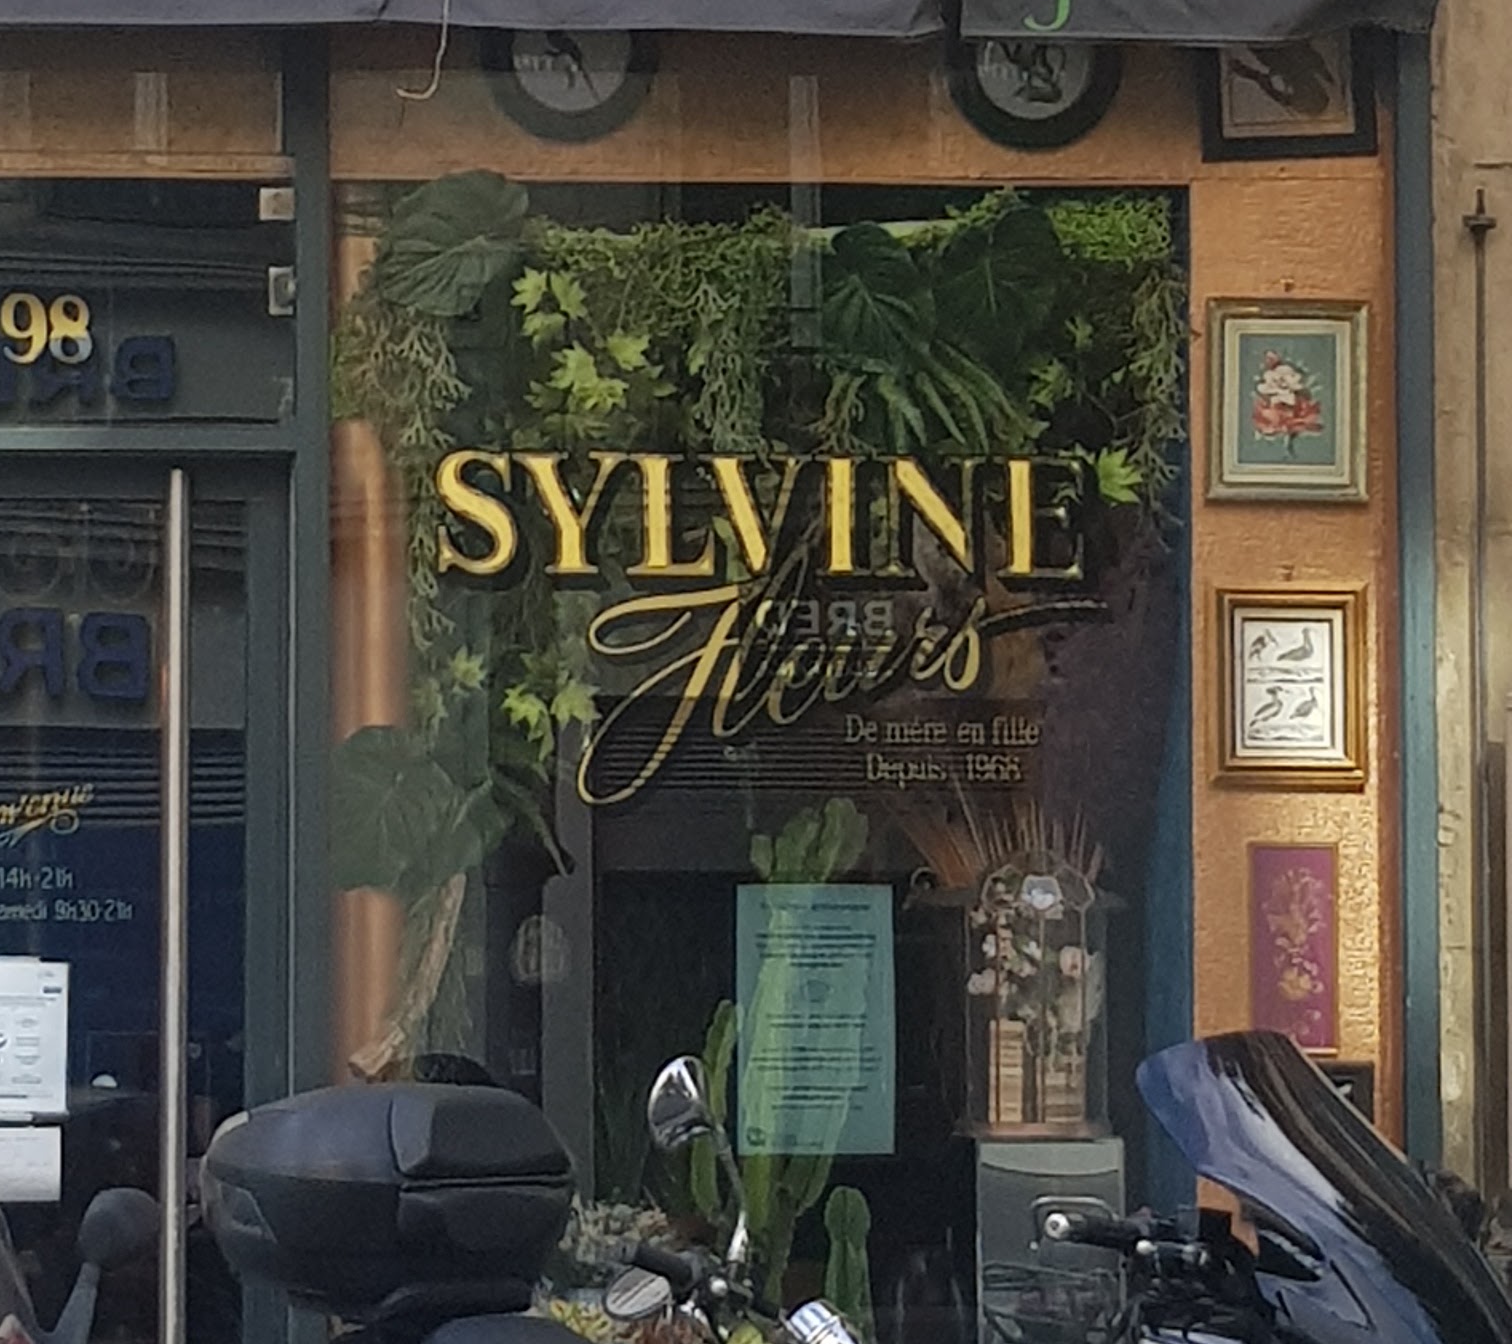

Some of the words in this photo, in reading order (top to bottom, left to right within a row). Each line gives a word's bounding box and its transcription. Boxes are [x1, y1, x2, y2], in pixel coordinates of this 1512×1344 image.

[0, 292, 92, 365] 98
[436, 449, 1084, 577] SYLVINE
[578, 501, 1107, 806] Fleurs
[845, 714, 877, 743] De
[957, 722, 984, 745] en
[992, 716, 1040, 746] fille
[865, 753, 948, 790] Depuis
